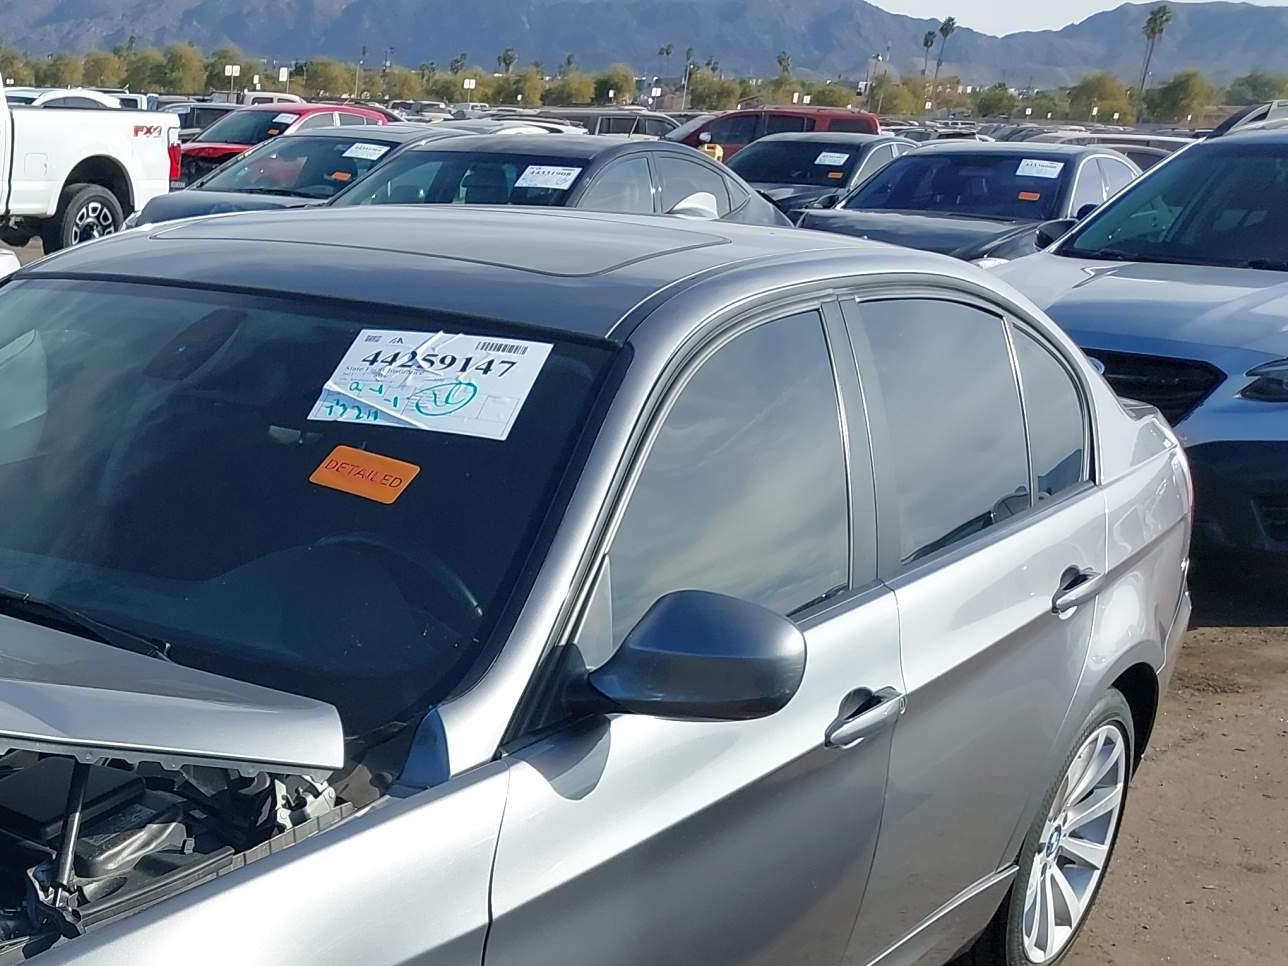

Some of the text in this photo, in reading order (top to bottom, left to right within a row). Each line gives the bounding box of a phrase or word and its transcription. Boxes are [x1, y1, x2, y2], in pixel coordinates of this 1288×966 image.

[133, 125, 162, 137] FX4
[362, 350, 517, 377] 44259147
[324, 458, 403, 488] DETAILED
